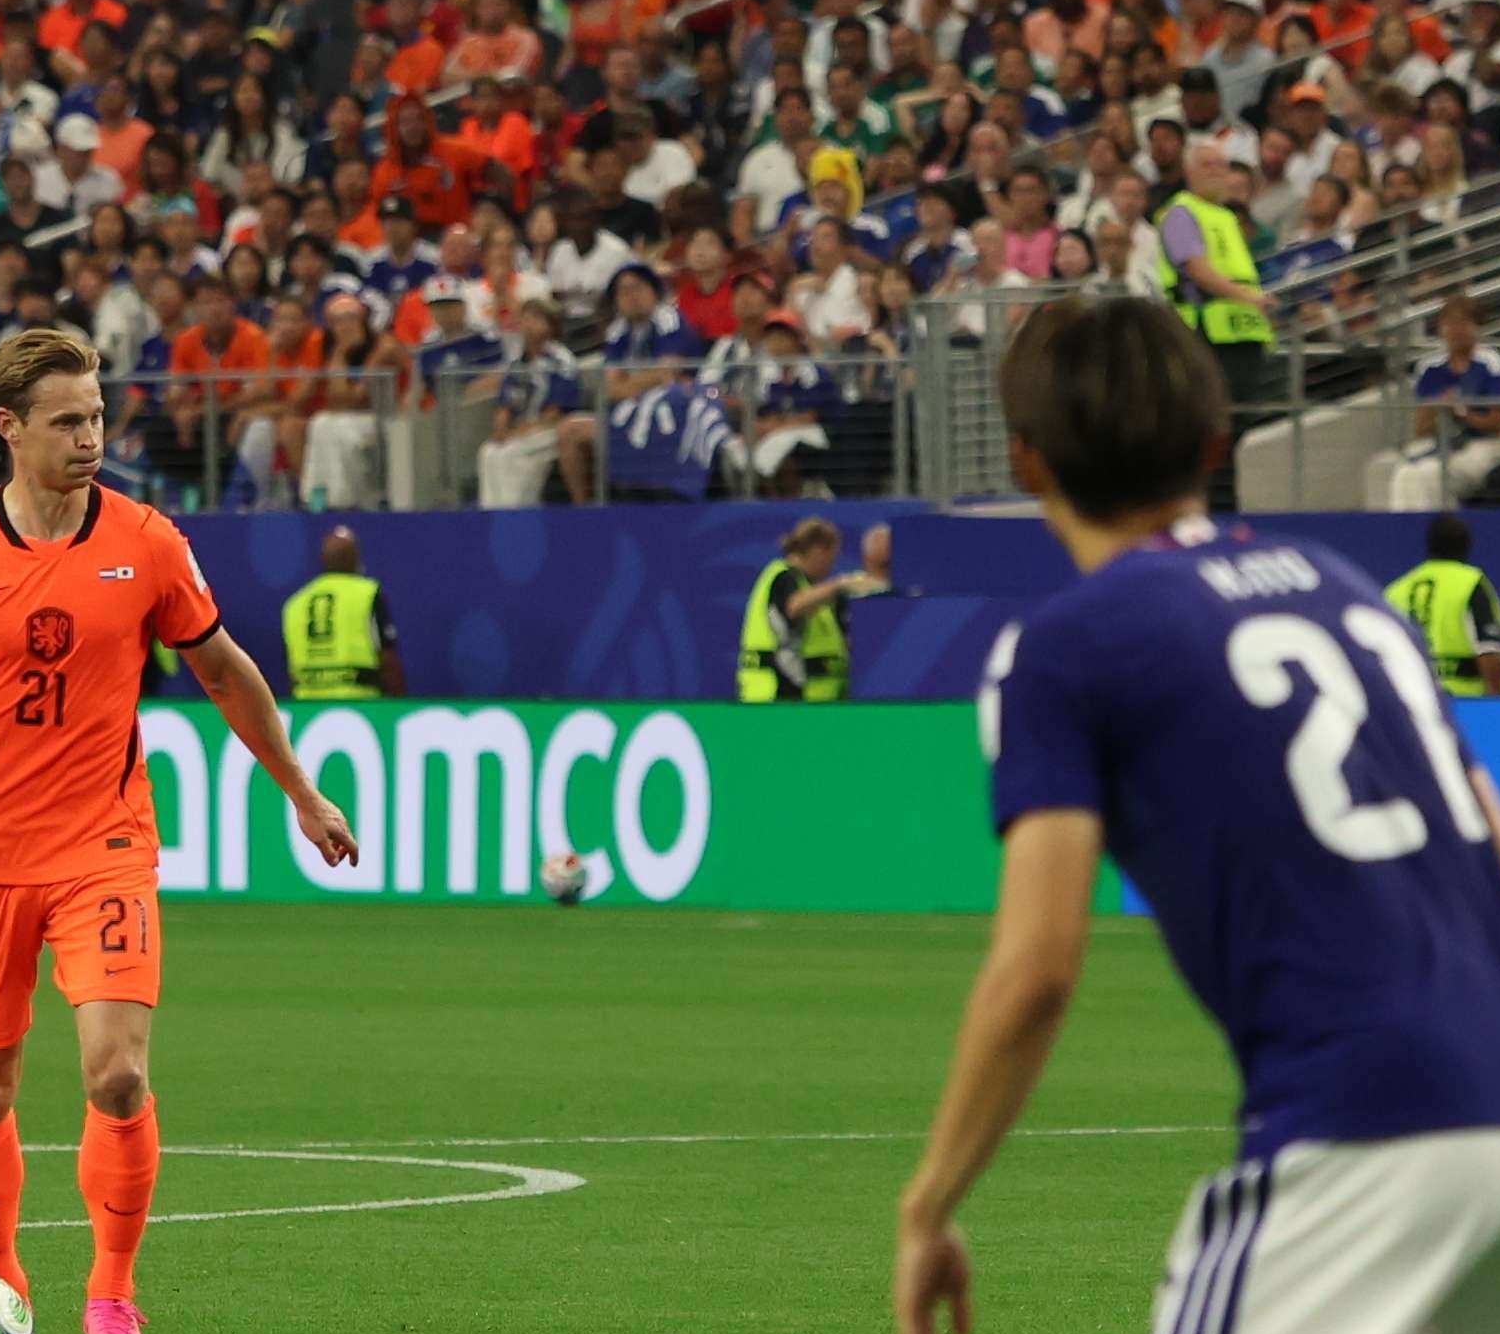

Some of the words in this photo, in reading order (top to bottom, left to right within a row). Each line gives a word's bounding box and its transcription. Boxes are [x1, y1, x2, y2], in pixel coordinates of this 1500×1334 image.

[15, 669, 67, 727] 21
[1226, 603, 1492, 862] 21
[137, 708, 710, 901] aramco
[100, 896, 148, 955] 21
